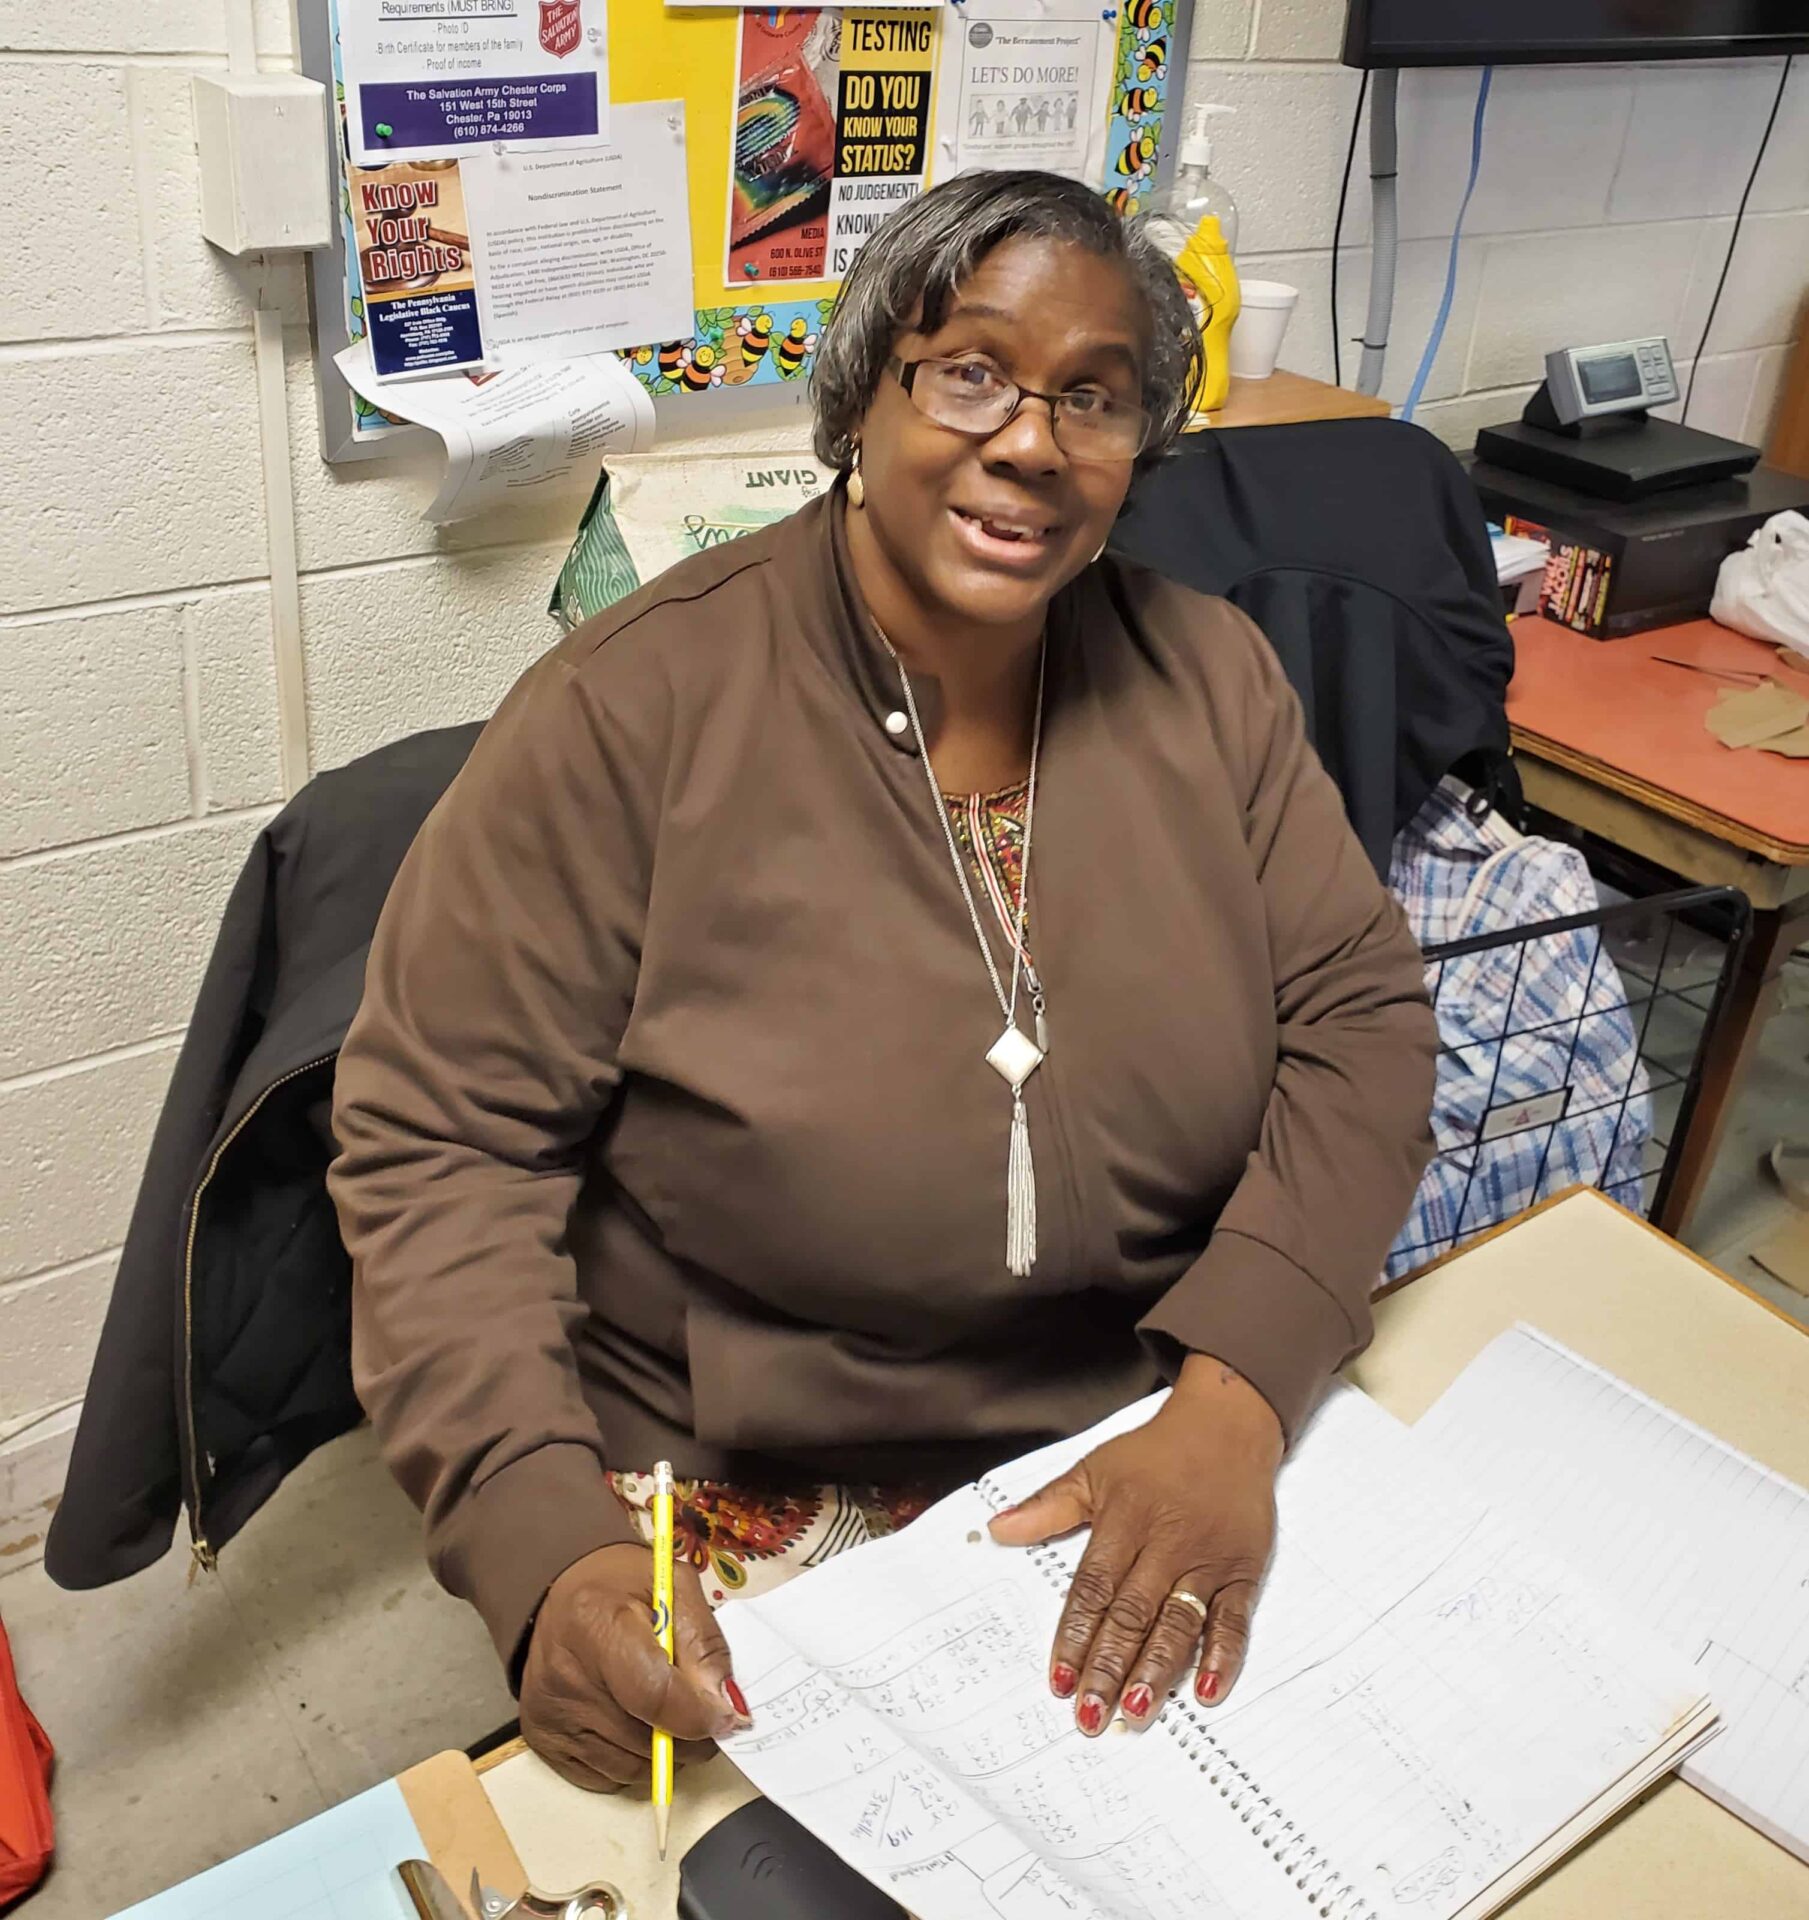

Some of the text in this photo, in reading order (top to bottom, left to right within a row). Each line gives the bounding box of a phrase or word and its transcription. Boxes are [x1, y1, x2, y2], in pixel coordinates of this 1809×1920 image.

[382, 2, 445, 15] Requirements
[547, 5, 563, 23] THE
[437, 23, 459, 34] Photo
[541, 7, 578, 43] SALVATION
[554, 24, 577, 50] ARMY
[851, 19, 931, 52] TESTING
[397, 41, 434, 54] Certificate
[436, 40, 445, 52] for
[447, 40, 480, 52] members
[482, 39, 489, 50] of
[491, 39, 502, 50] the
[504, 38, 523, 51] family
[427, 57, 481, 70] Proof of income
[971, 66, 1079, 83] LET'S DO MORE!
[406, 83, 566, 100] The Salvation Army Chester Corps
[846, 76, 920, 110] DO YOU
[440, 98, 537, 112] 151 West 15th Street
[446, 110, 532, 125] Chester, Pa 19013
[843, 116, 917, 137] KNOW YOUR
[454, 123, 524, 138] (610) 874-4266
[536, 160, 567, 171] Department
[576, 156, 603, 166] Agriculture
[841, 144, 915, 173] STATUS?
[360, 180, 437, 212] Know
[528, 183, 622, 202] Nondiscrimination Statement
[838, 182, 919, 201] NO JUDGEMENT!
[365, 217, 428, 246] Your
[801, 228, 824, 239] MEDIA
[770, 246, 824, 259] 600 N. OLIVE ST
[833, 248, 848, 273] IS
[369, 245, 462, 281] Rights
[391, 294, 456, 310] The Pennsylvania
[379, 309, 419, 322] Legislative
[420, 306, 441, 316] Black
[442, 303, 470, 313] Caucus
[746, 469, 817, 488] GIANT
